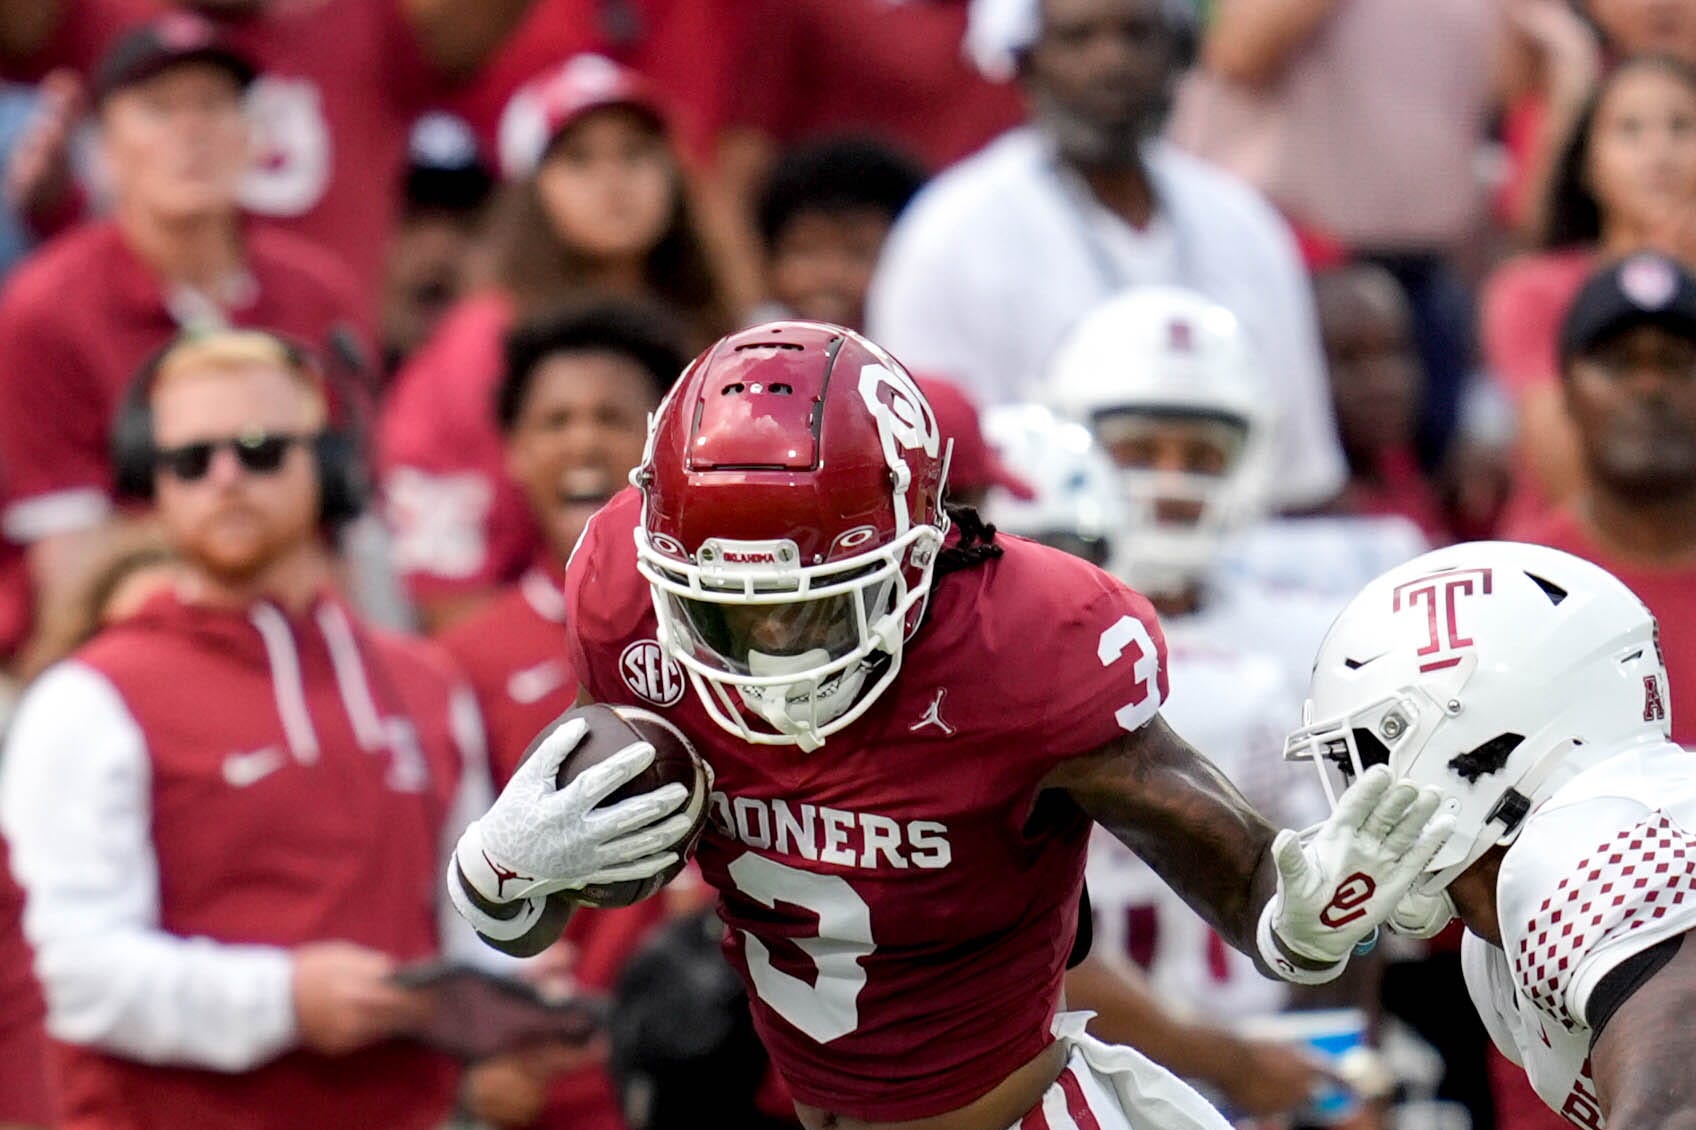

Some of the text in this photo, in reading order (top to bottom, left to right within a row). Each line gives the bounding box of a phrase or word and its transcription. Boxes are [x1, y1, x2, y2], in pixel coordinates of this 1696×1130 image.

[723, 551, 775, 564] OKLAHOMA
[1393, 567, 1493, 673] T
[624, 644, 681, 703] SEC
[1097, 615, 1162, 732] 3
[1643, 674, 1664, 722] A
[706, 791, 952, 869] OONERS
[727, 850, 878, 1045] 3
